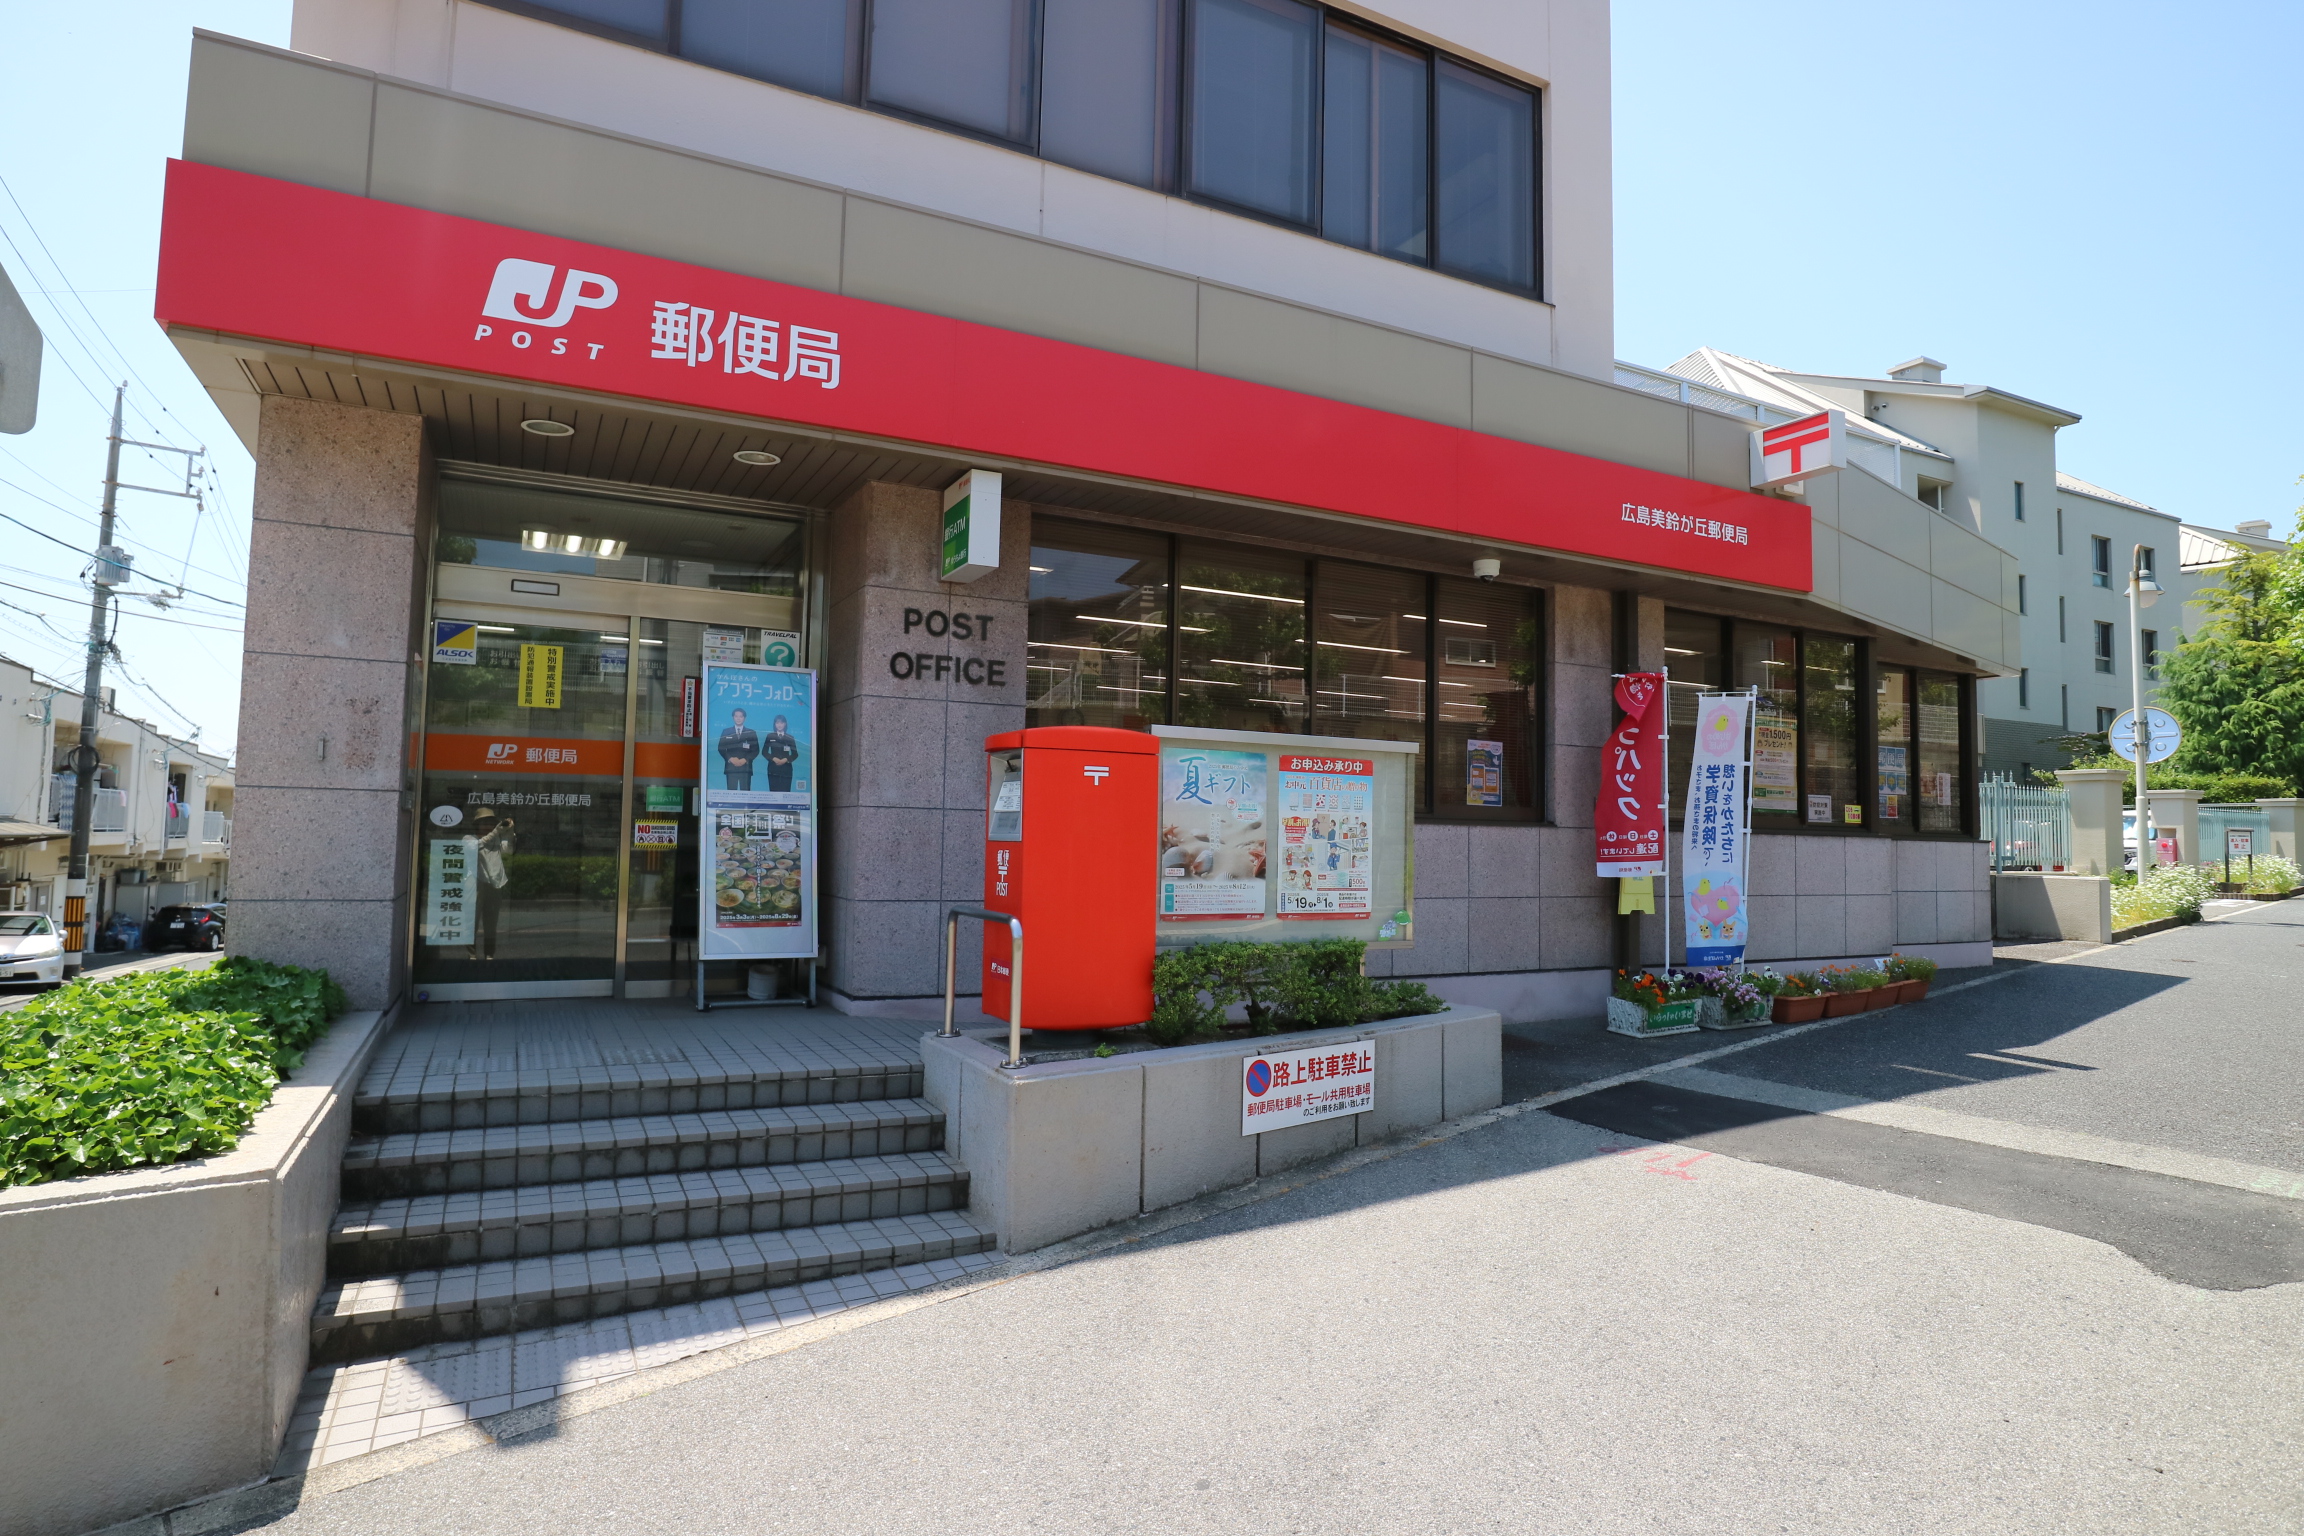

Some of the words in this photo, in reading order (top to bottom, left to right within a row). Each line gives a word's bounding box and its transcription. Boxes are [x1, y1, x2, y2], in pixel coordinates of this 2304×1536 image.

[482, 258, 618, 328] JP
[651, 301, 841, 390] 郵便局
[474, 324, 604, 361] POST
[944, 516, 967, 542] 銀行ATM
[1621, 502, 1749, 546] 広島美鈴が丘郵便局
[763, 630, 797, 639] TRAVELPAL
[903, 608, 994, 641] POST
[436, 648, 475, 658] ALSOK
[544, 647, 558, 707] 特別警戒実施中
[889, 651, 1006, 687] OFFICE
[716, 681, 803, 701] アフターフォロー
[487, 743, 518, 759] JP
[525, 747, 578, 765] 郵便局
[1878, 751, 1904, 766] 郵便局
[1290, 757, 1364, 774] お申込み承り中
[1285, 780, 1307, 790] お中元
[1309, 776, 1368, 792] 百貨店の贈り物
[467, 792, 592, 807] 広島美鈴が丘郵便局
[637, 824, 651, 834] NO
[997, 849, 1010, 867] 郵便
[439, 844, 465, 941] 夜間警戒強化中
[996, 882, 1008, 897] POST
[1649, 1008, 1693, 1023] いらっしゃいませ
[1272, 1050, 1373, 1089] 路上駐車禁止
[1247, 1082, 1371, 1117] 郵便局駐車場・モール共用駐車場
[1303, 1096, 1371, 1117] のご利用をお願い致します
